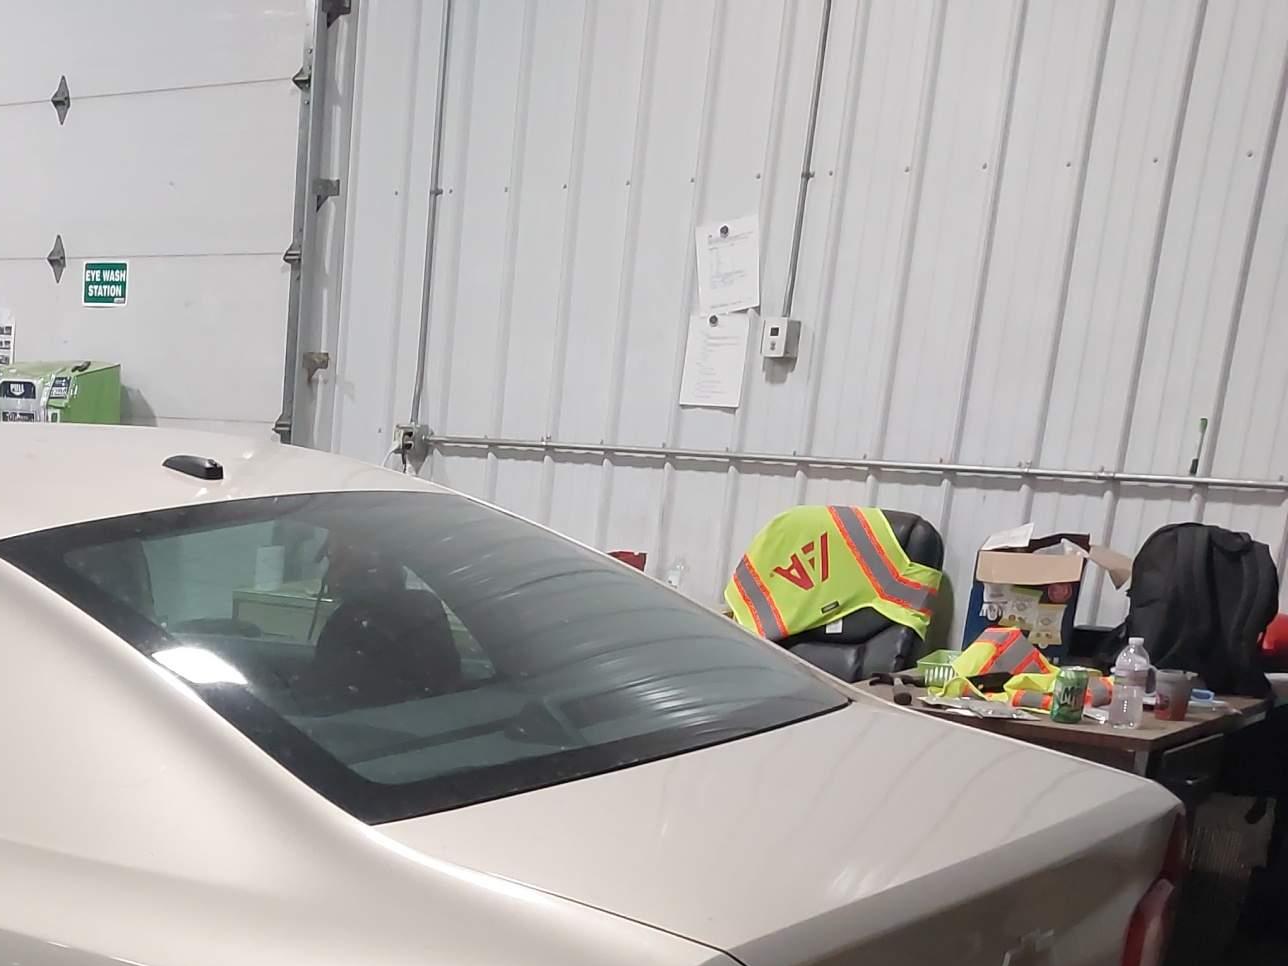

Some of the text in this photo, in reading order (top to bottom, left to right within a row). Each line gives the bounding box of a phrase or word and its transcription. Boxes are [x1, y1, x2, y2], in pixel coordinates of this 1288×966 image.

[85, 269, 126, 281] EYE WASH
[88, 285, 122, 297] STATION
